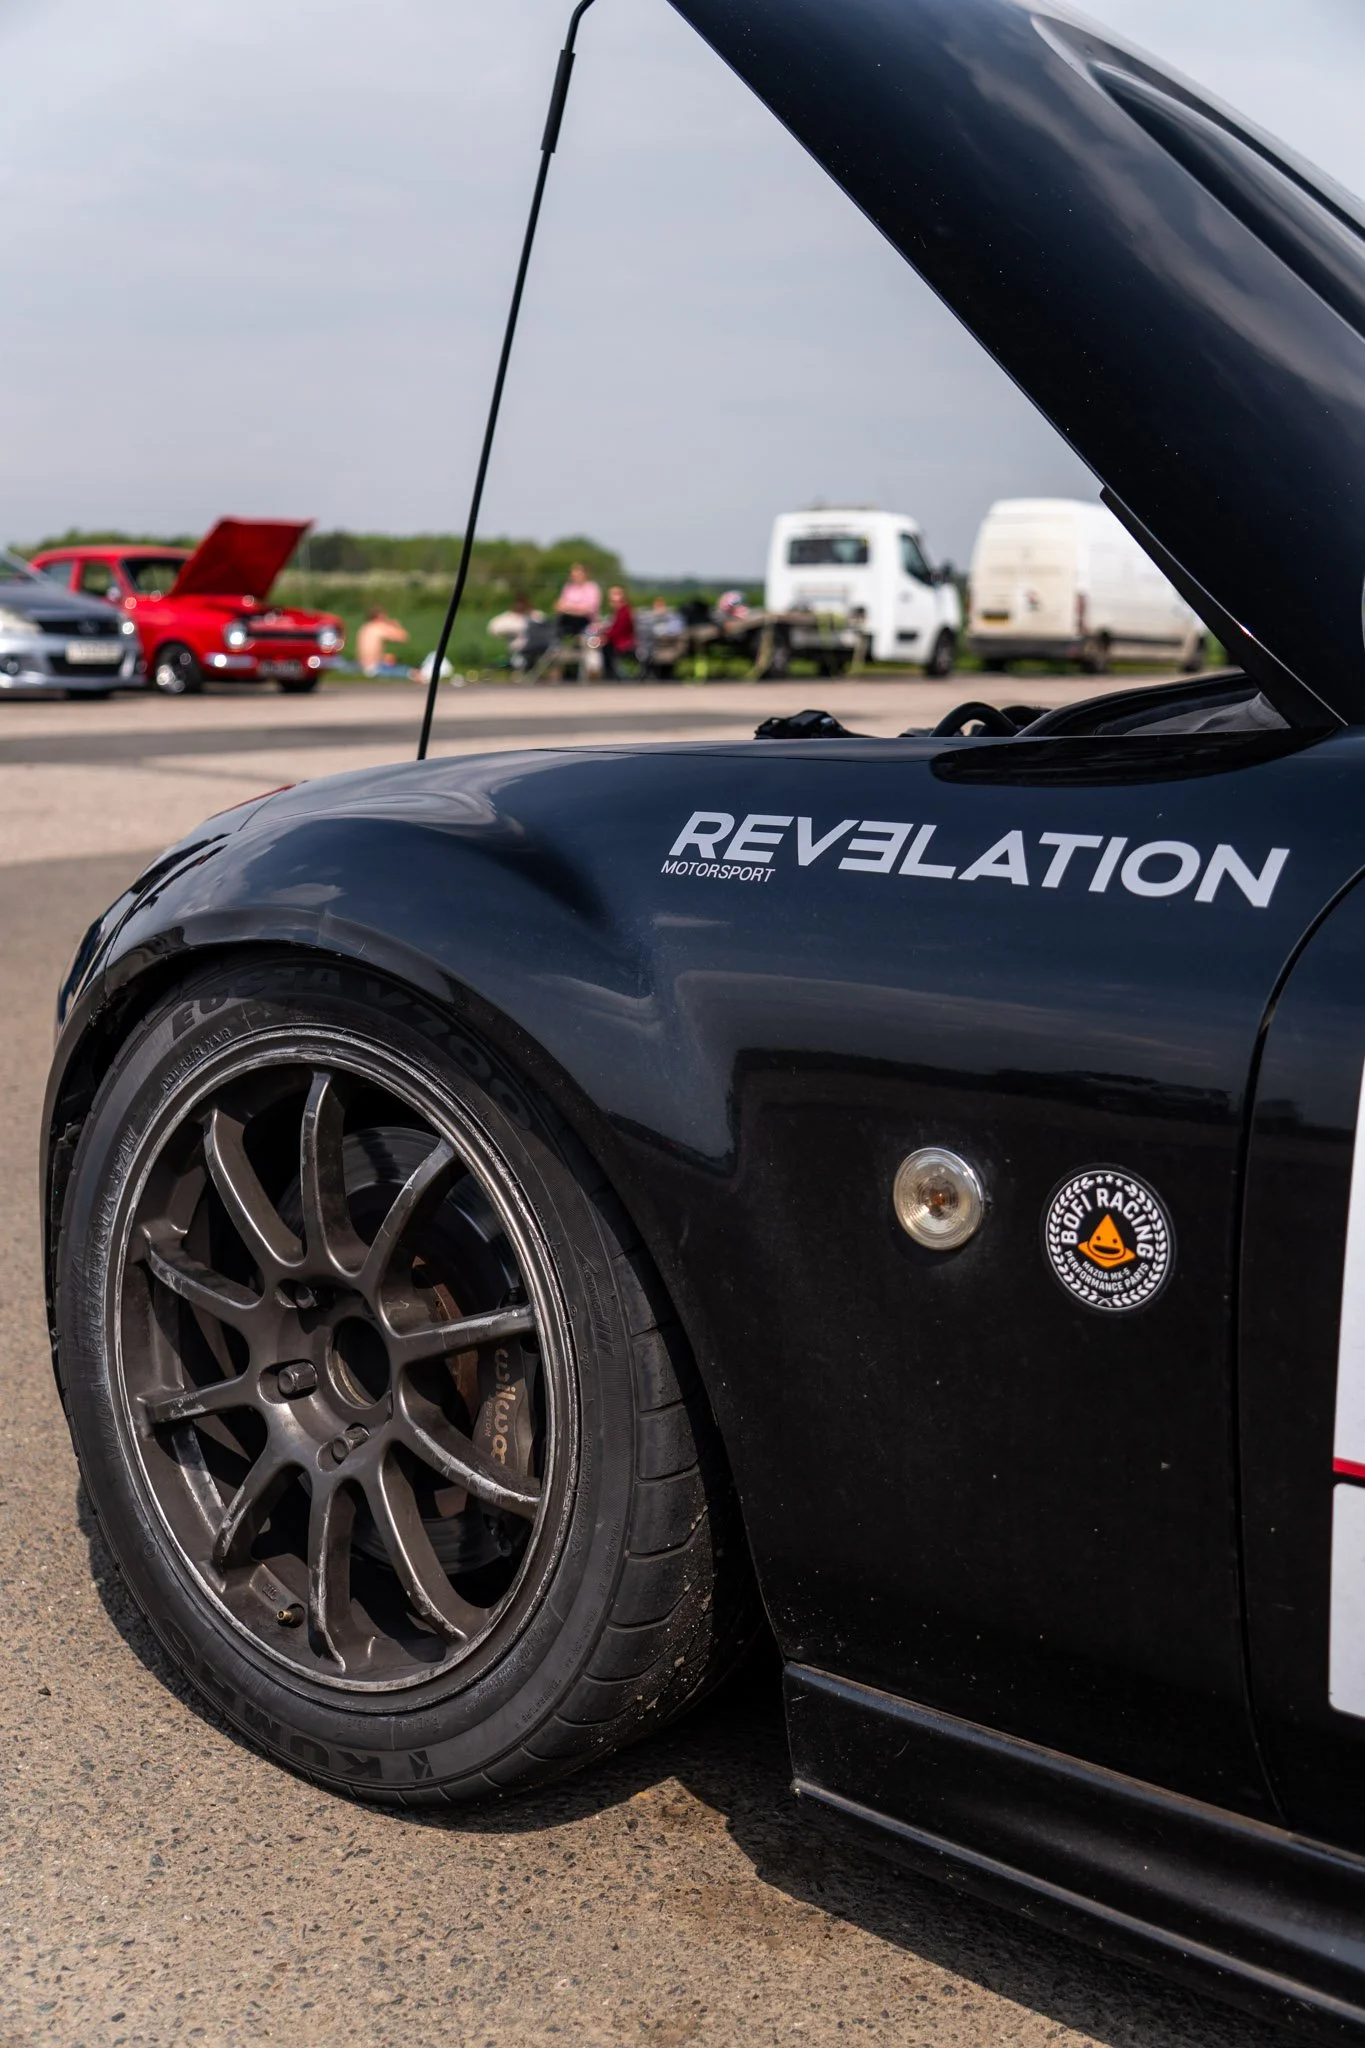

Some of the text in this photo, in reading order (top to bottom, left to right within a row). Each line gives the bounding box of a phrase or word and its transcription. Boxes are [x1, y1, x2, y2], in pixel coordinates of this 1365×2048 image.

[660, 860, 776, 883] MOTORSPORT
[365, 975, 534, 1138] V700
[1060, 1188, 1154, 1258] BOFI RACING
[1064, 1250, 1149, 1292] PERFORMANCE PARTS
[1082, 1261, 1131, 1281] MAZDA MX-5
[154, 1610, 382, 1778] KUMHO
